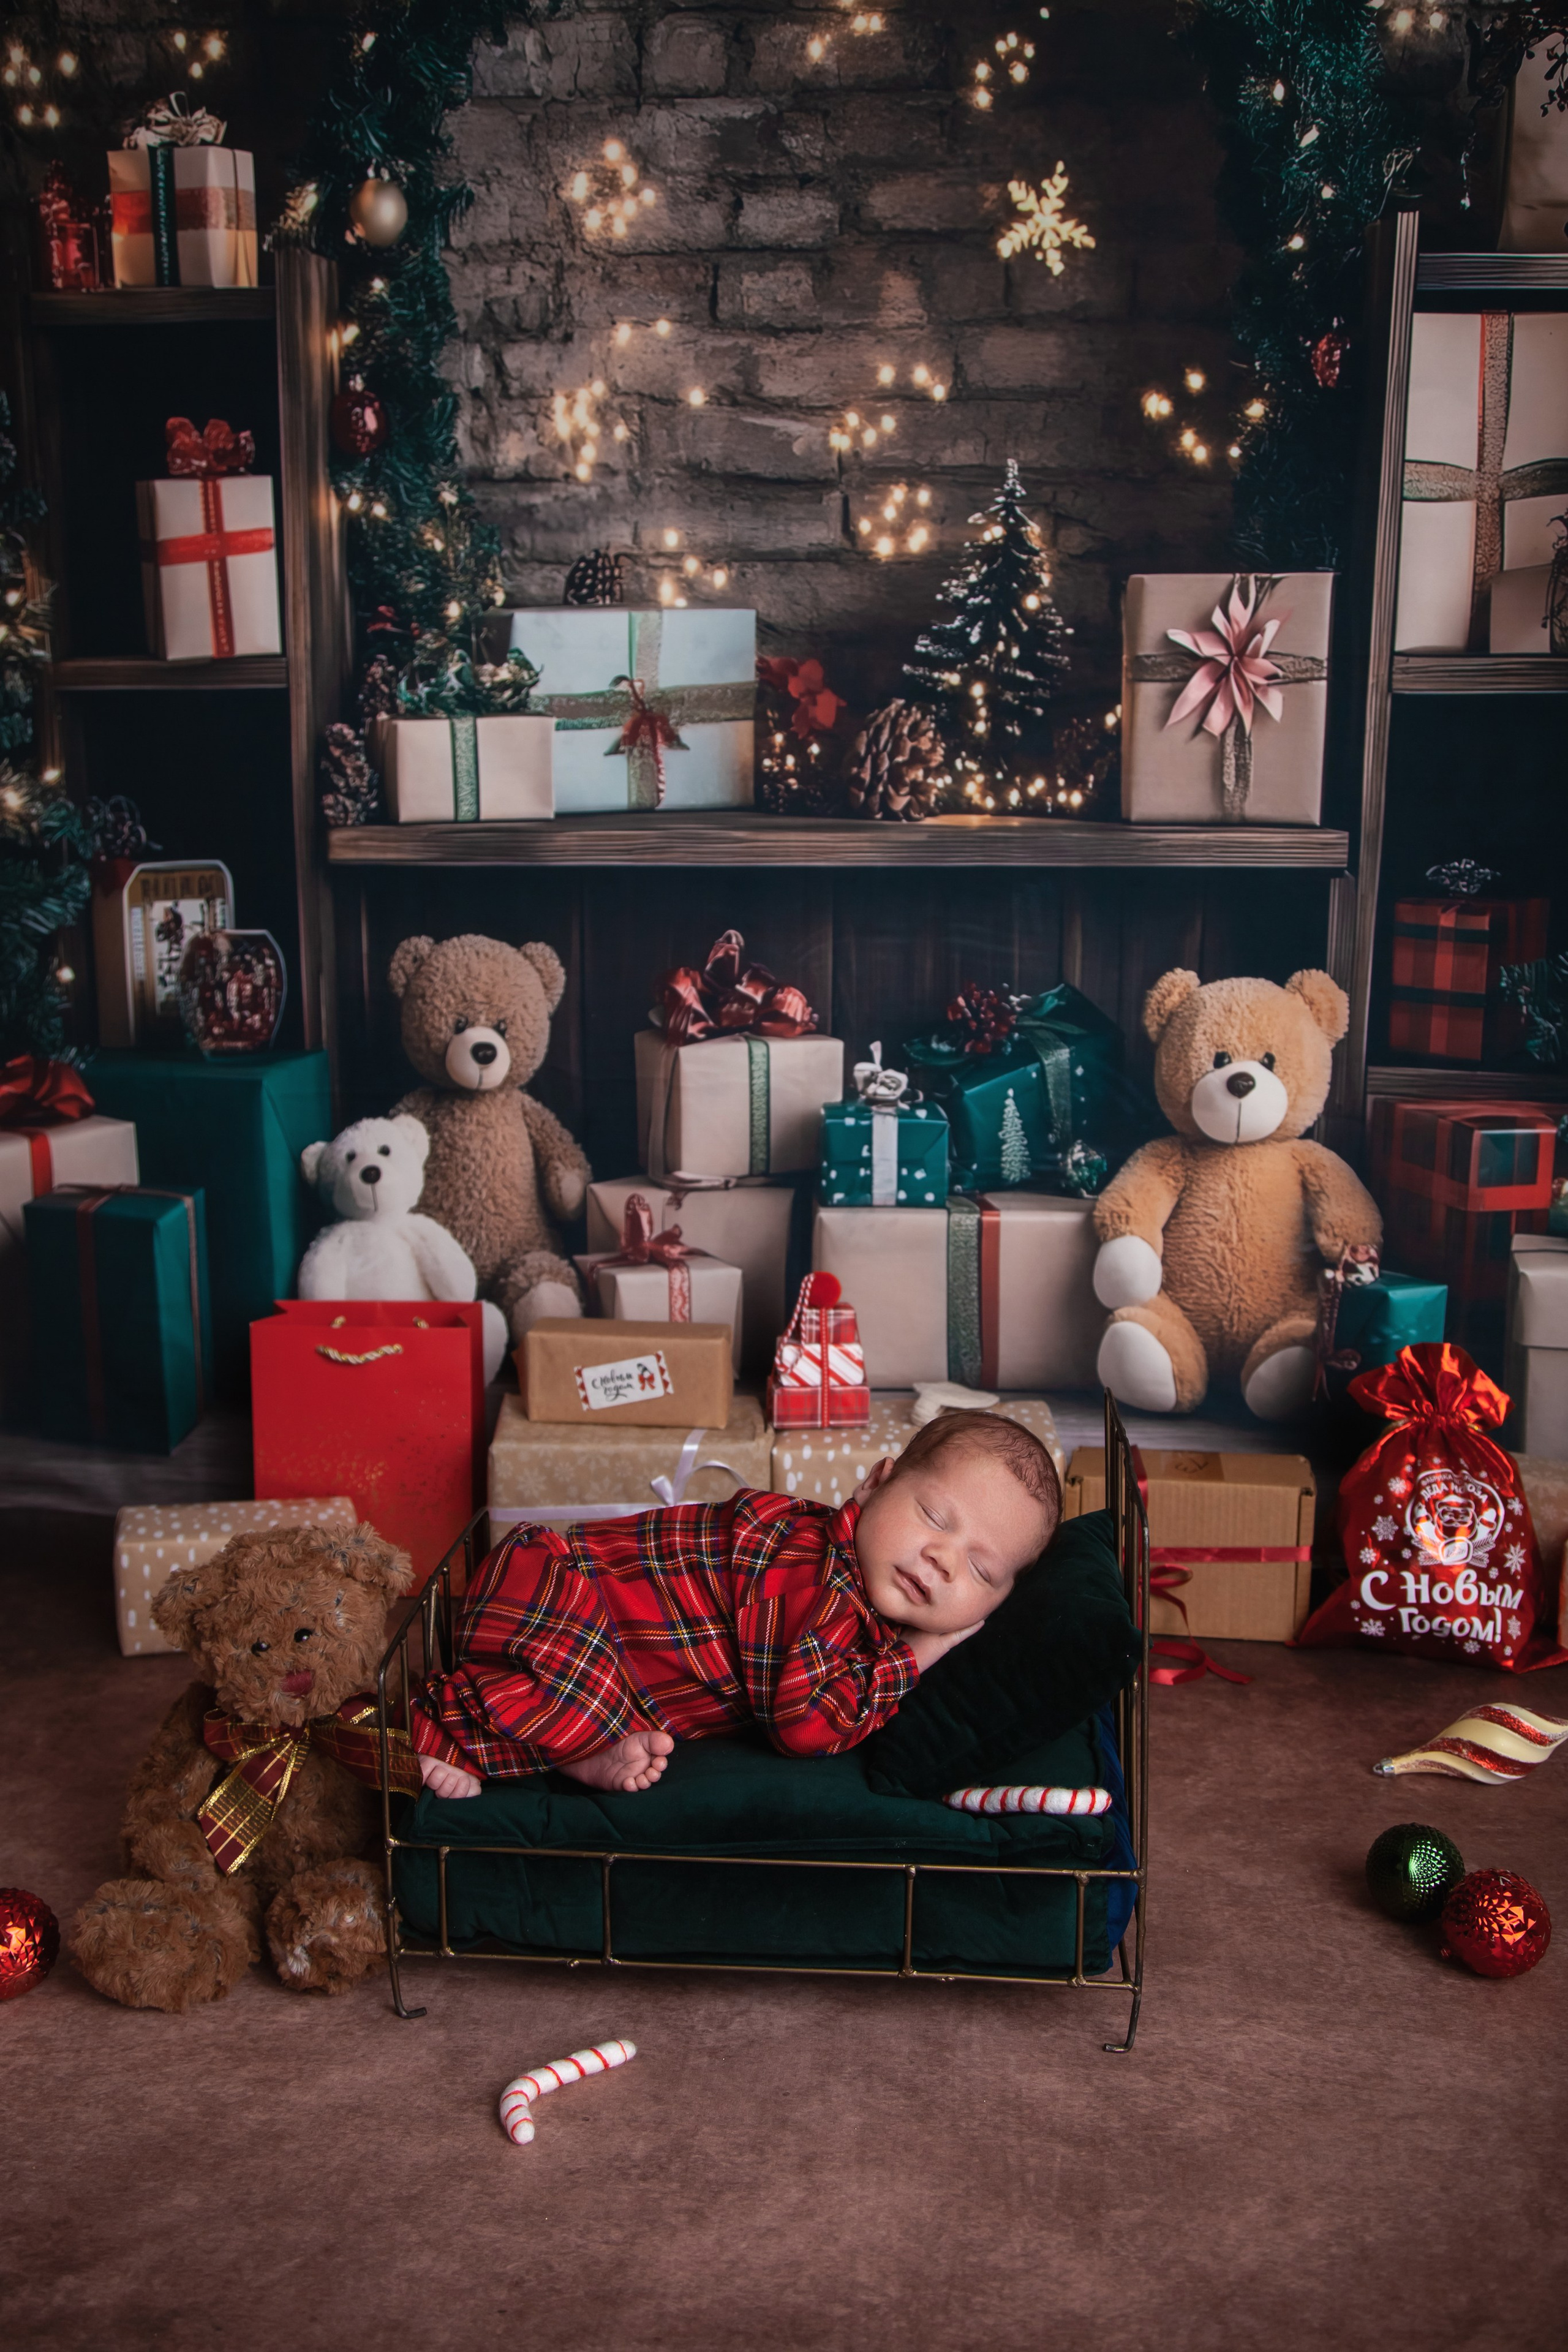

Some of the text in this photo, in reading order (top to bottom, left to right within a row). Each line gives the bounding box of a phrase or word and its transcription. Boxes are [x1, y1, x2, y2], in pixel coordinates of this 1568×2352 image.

[1420, 1482, 1449, 1502] ДЕДА
[1451, 1482, 1488, 1504] МООЗА
[1360, 1569, 1525, 1611] С Новым
[1398, 1607, 1502, 1643] Годом!
